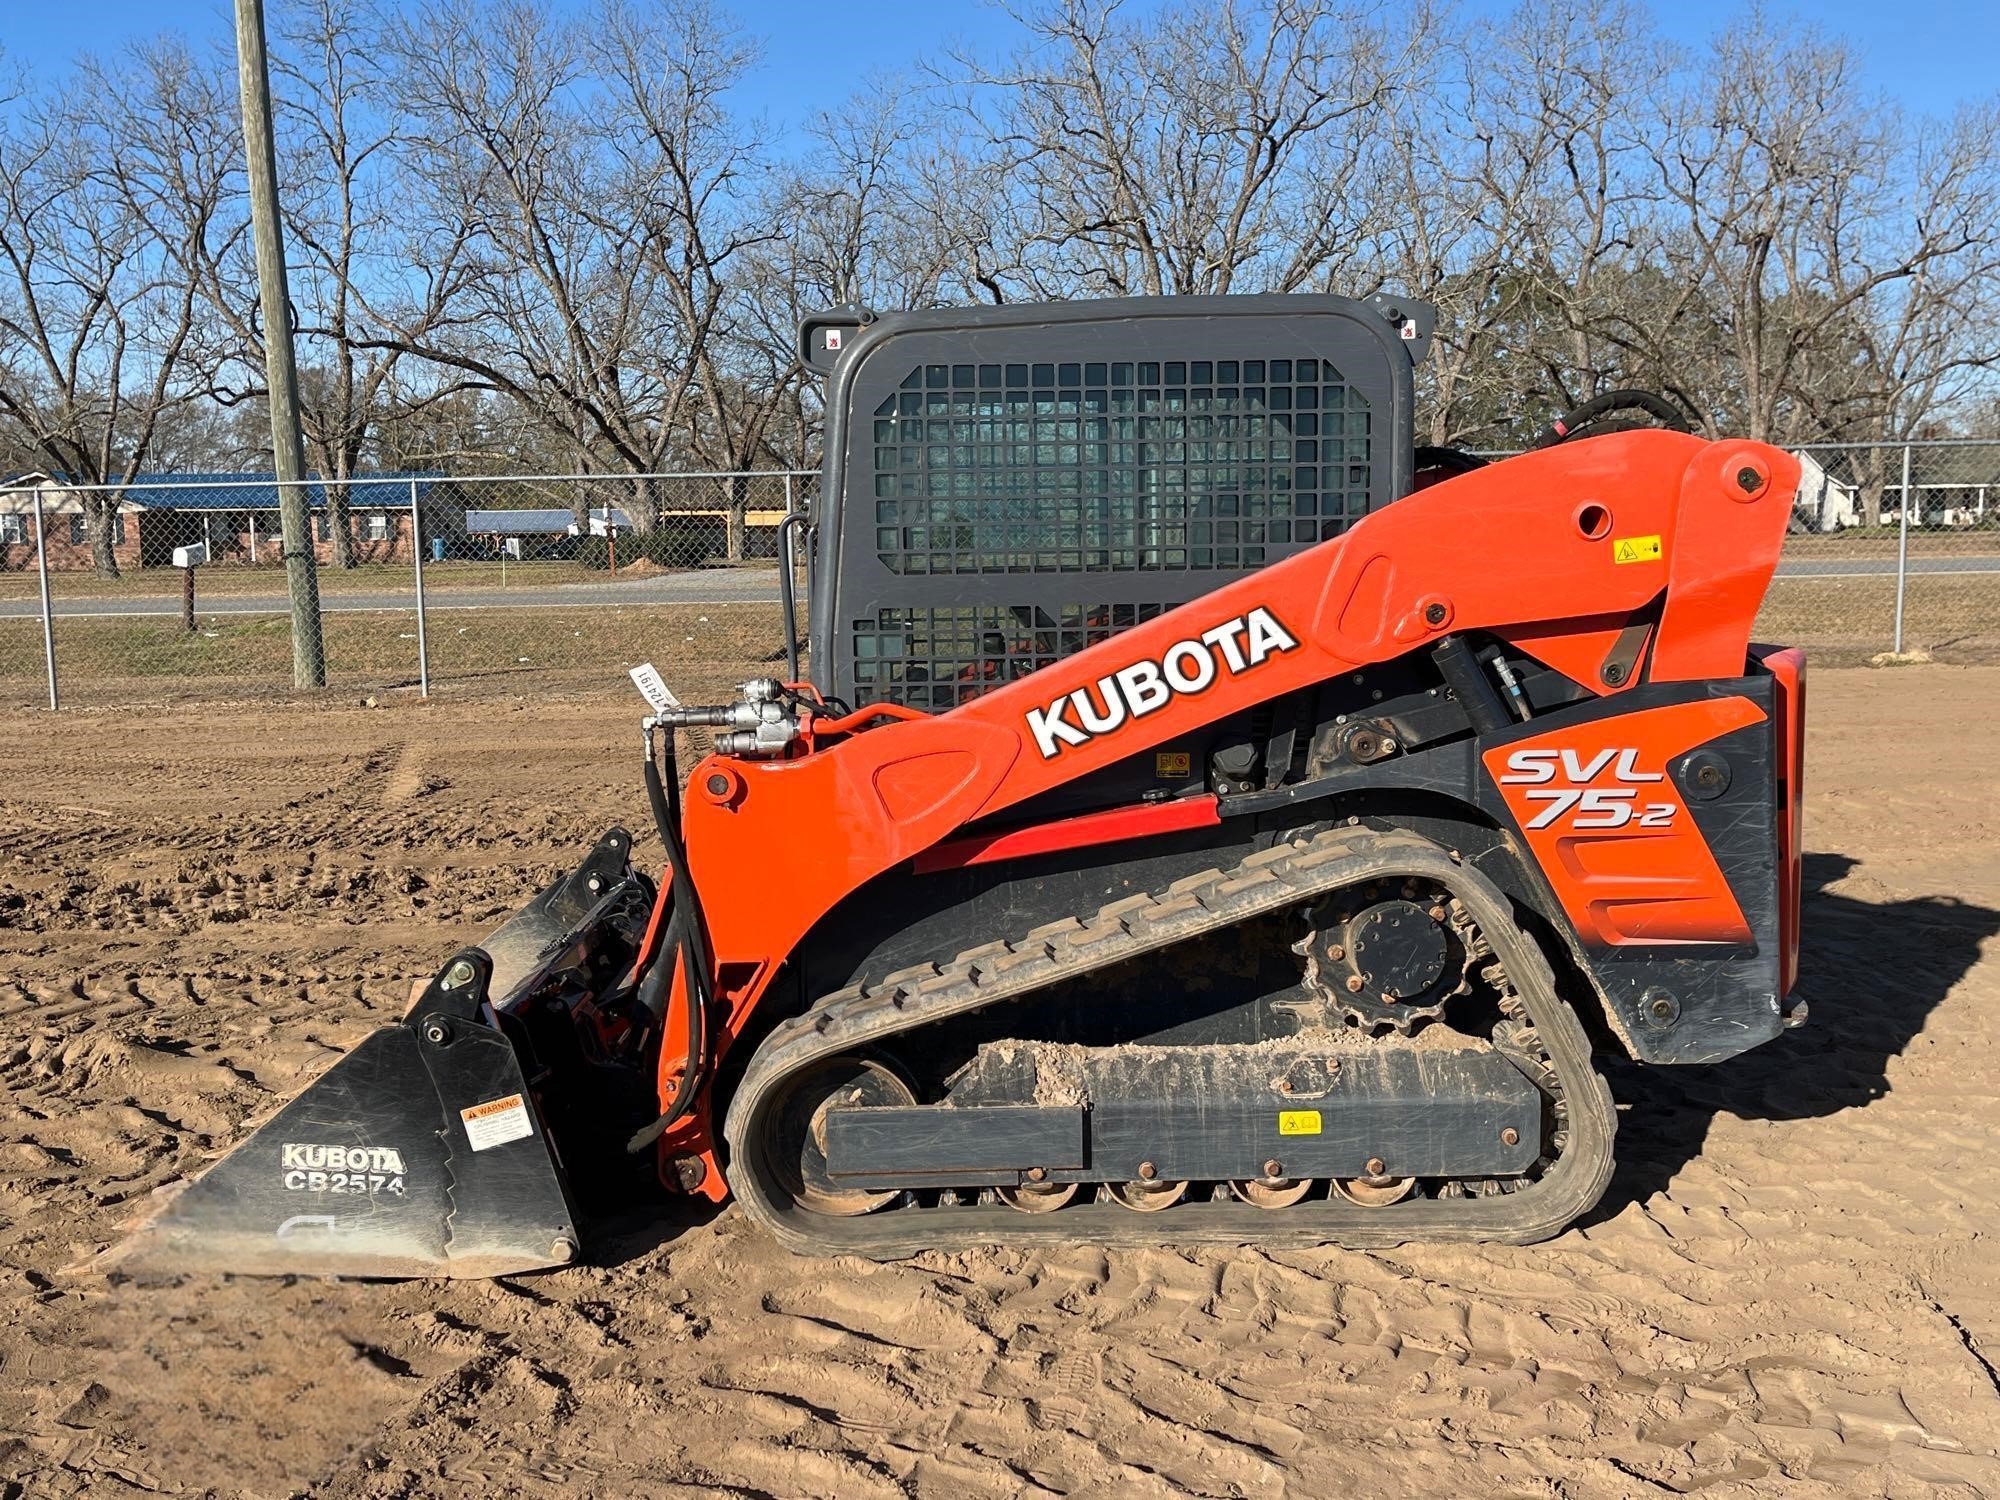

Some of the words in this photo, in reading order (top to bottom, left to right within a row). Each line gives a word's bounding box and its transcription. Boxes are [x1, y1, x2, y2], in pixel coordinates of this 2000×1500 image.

[637, 672, 665, 704] 124191
[1025, 607, 1299, 759] KUBOTA
[1499, 748, 1664, 784] SVL
[1525, 788, 1677, 829] 75-2
[478, 1098, 519, 1116] WARNING
[283, 1143, 406, 1173] KUBOTA
[284, 1170, 404, 1196] CB2574
